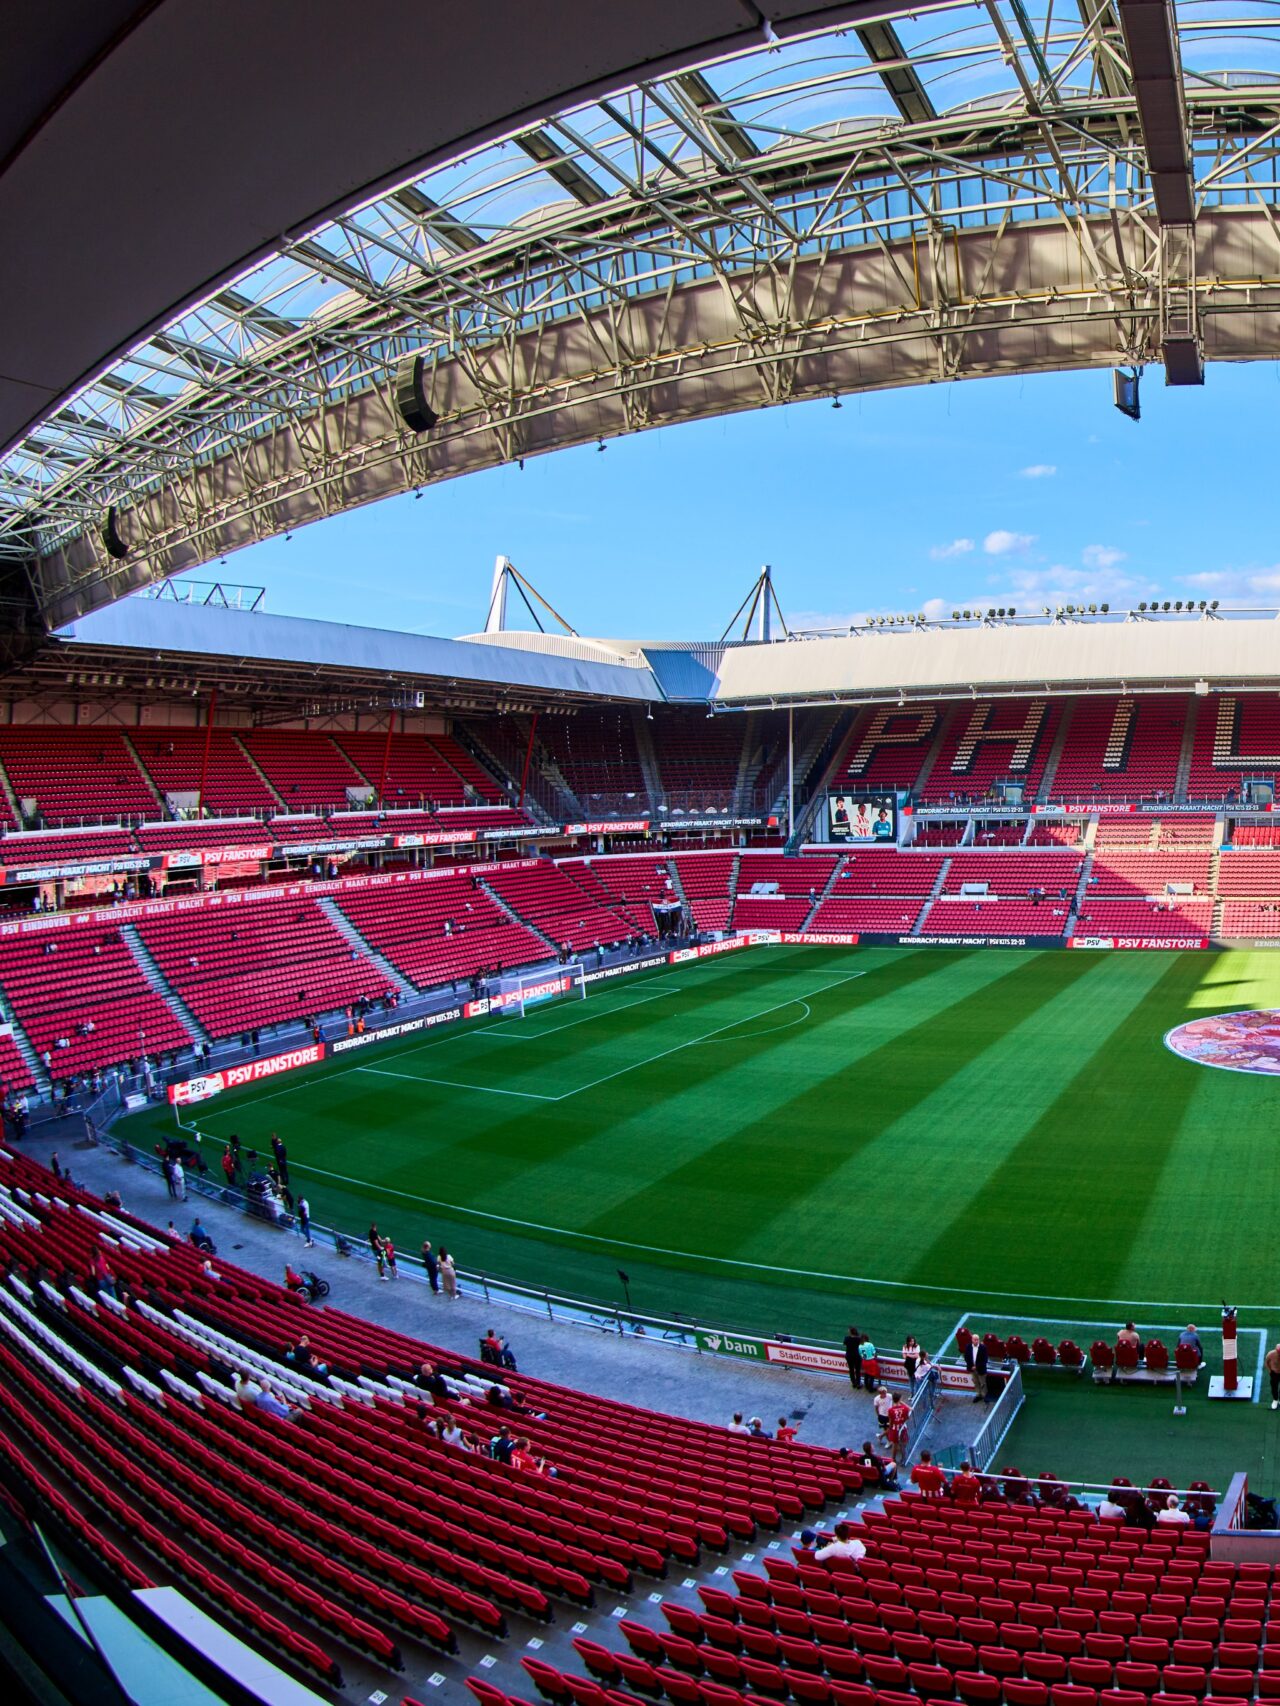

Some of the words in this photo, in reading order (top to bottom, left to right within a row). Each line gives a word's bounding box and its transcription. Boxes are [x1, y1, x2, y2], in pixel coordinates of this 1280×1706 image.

[588, 824, 602, 832] PSV
[604, 822, 644, 830] FANSTORE
[426, 834, 438, 844] PSV
[440, 832, 473, 842] FANSTORE
[204, 852, 222, 862] PSV
[223, 848, 268, 860] FANSTORE
[471, 864, 500, 873] EENDRACHT
[502, 862, 519, 870] MAAKT
[522, 860, 538, 868] MACHT
[410, 872, 420, 880] PSV
[424, 868, 454, 878] EINDHOVEN
[305, 880, 342, 893] EENDRACHT
[346, 878, 368, 888] MAAKT
[371, 876, 392, 885] MACHT
[228, 894, 241, 903] PSV
[245, 889, 284, 900] EINDHOVEN
[96, 906, 143, 921] EENDRACHT
[146, 902, 174, 914] MAAKT
[178, 899, 204, 910] MACHT
[2, 924, 18, 935] PSV
[23, 916, 70, 931] EINDHOVEN
[784, 934, 802, 942] PSV
[804, 934, 853, 944] FANSTORE
[1118, 939, 1140, 948] PSV
[1142, 939, 1202, 948] FANSTORE
[700, 946, 713, 956] PSV
[714, 937, 744, 954] FANSTORE
[334, 1032, 376, 1052] EENDRACHT
[376, 1026, 400, 1040] MAAKT
[401, 1019, 424, 1034] MACHT
[428, 1016, 436, 1026] PSV
[436, 1013, 446, 1024] KITS
[447, 1009, 460, 1021] 22-23
[228, 1066, 253, 1086] PSV
[254, 1046, 318, 1077] FANSTORE
[191, 1080, 206, 1093] PSV
[724, 1336, 757, 1356] bam
[779, 1350, 818, 1364] Stadions
